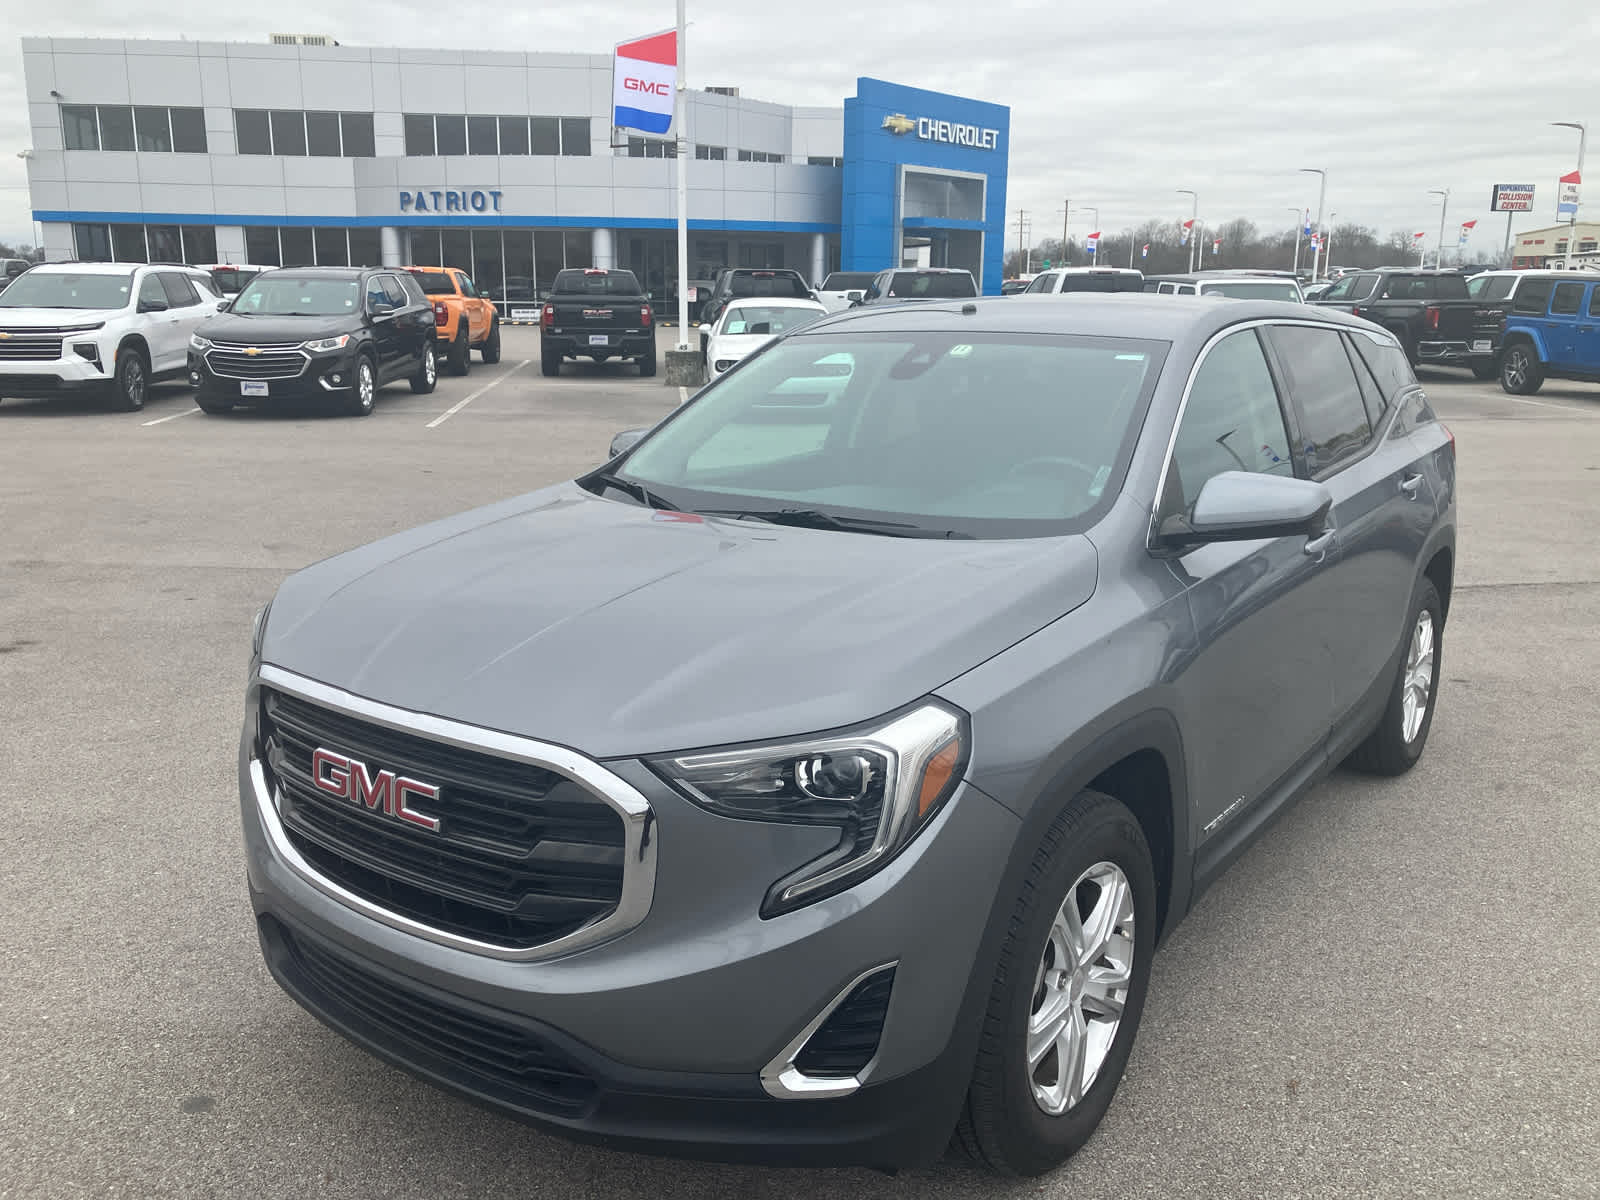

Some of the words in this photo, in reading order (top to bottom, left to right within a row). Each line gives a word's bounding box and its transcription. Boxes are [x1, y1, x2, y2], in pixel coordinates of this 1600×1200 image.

[624, 77, 670, 96] GMC
[918, 117, 999, 149] CHEVROLET
[399, 191, 503, 212] PATRIOT
[1498, 192, 1533, 201] COLLISION
[1501, 201, 1528, 209] CENTER
[312, 747, 441, 833] GMC
